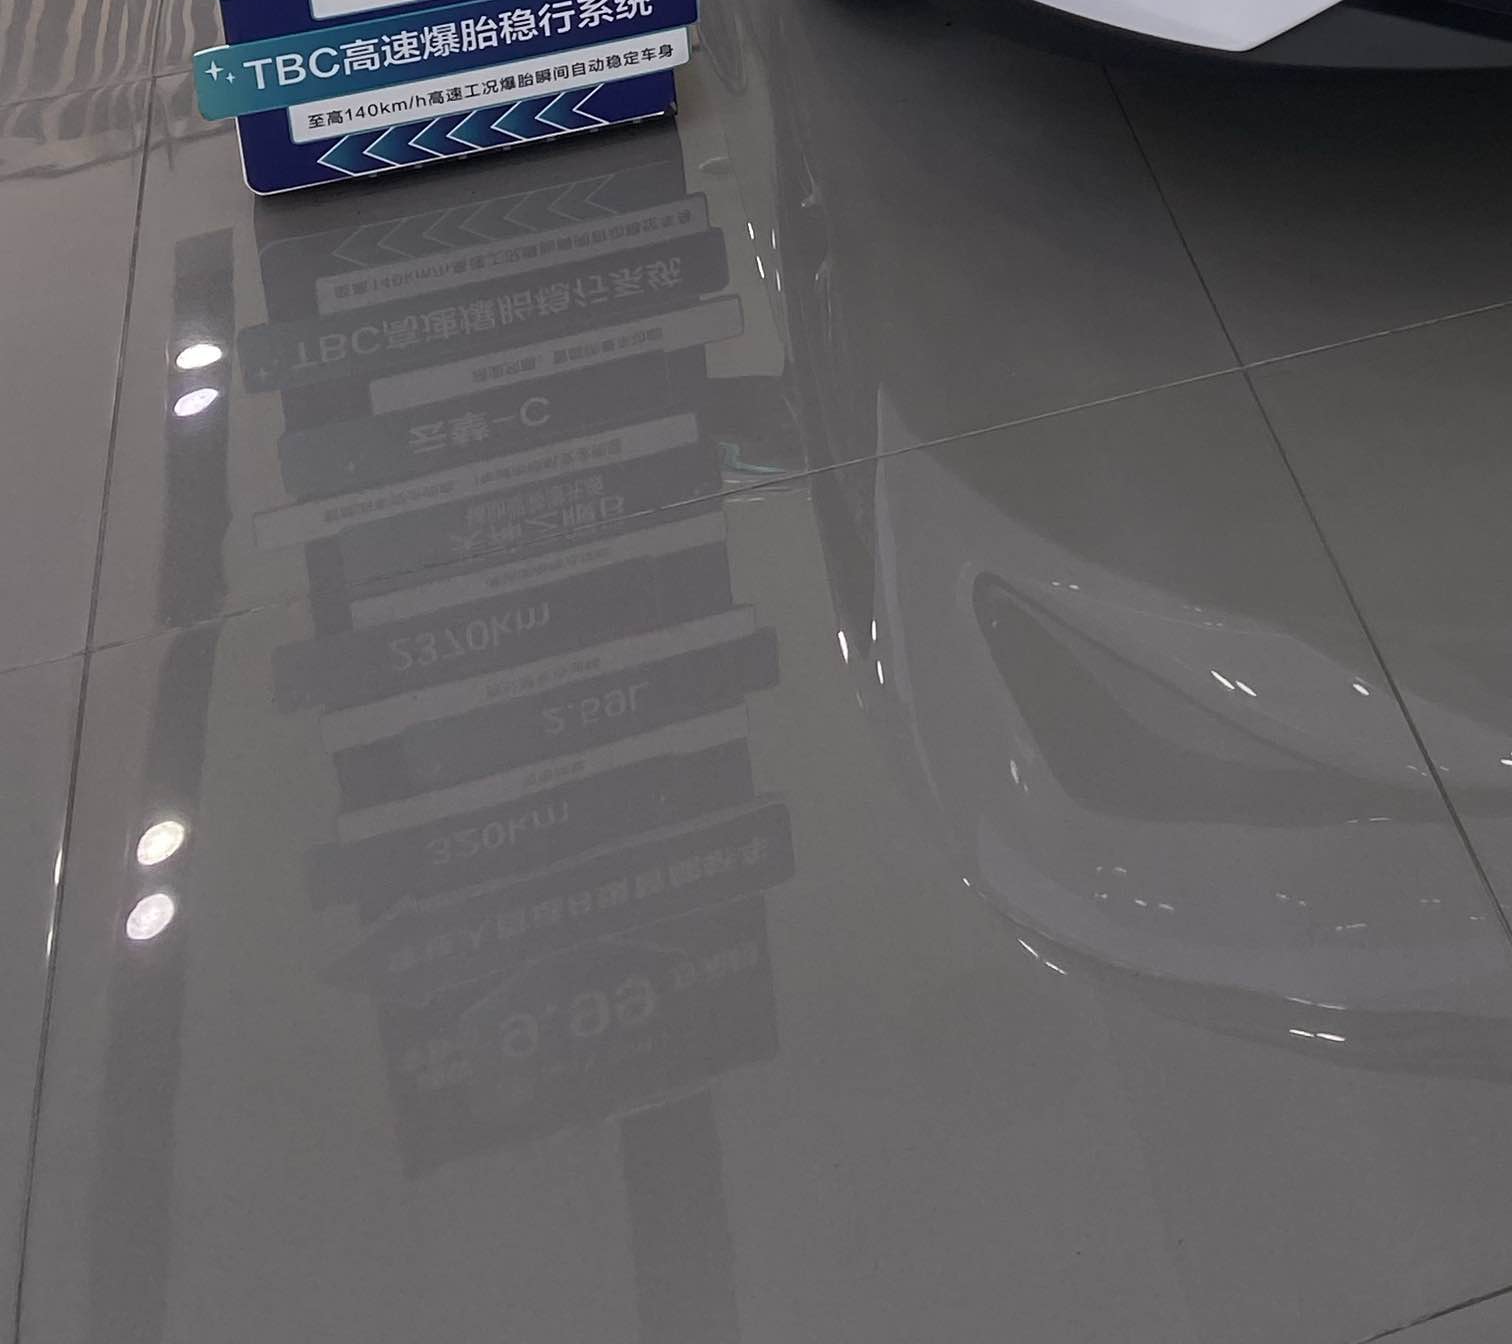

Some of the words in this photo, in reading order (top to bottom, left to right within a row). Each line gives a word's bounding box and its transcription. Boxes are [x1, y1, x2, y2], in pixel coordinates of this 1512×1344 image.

[307, 43, 675, 130] 至高140km/h高速工况爆胎瞬间自动稳定车身
